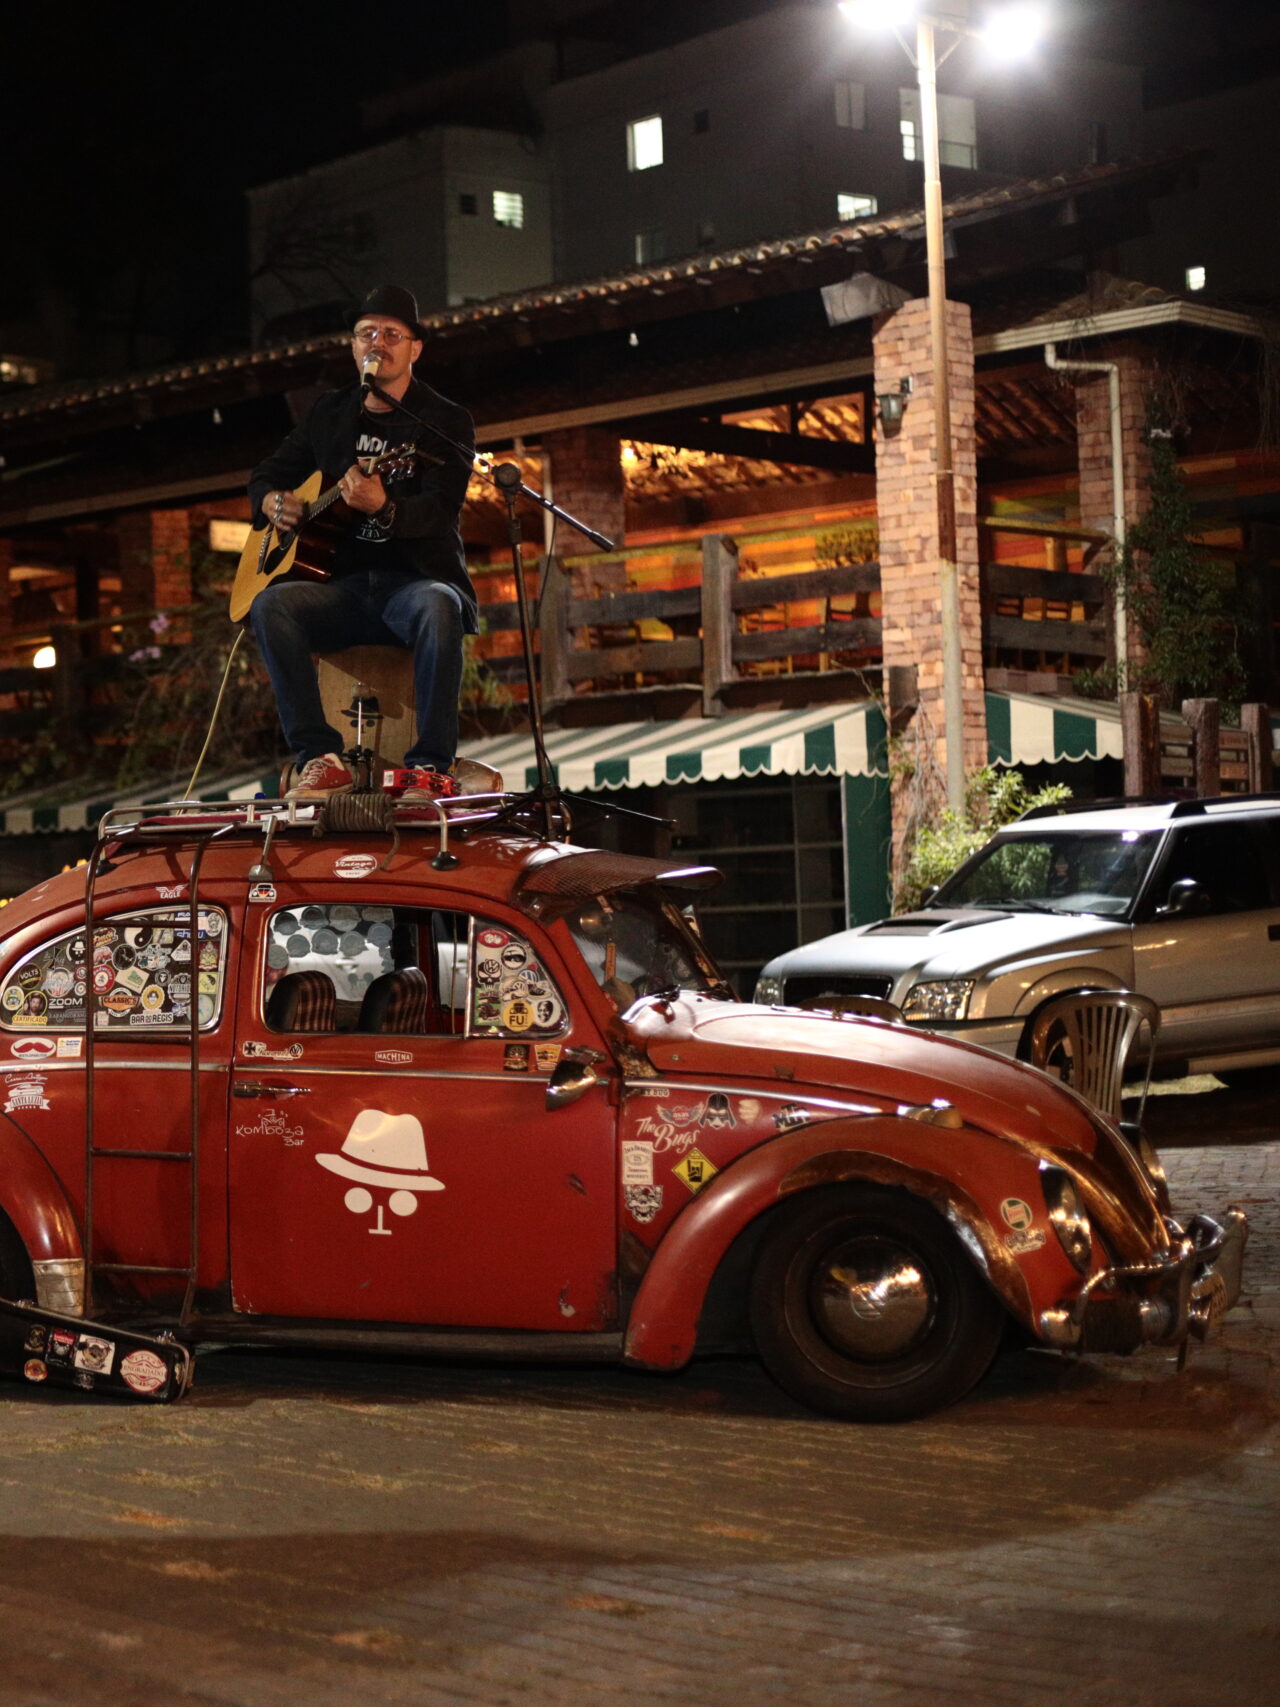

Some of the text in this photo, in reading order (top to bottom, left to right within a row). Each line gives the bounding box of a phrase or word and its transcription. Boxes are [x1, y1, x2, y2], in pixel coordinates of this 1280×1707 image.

[160, 890, 182, 899] EAGLE
[19, 968, 40, 980] VOLTS
[48, 997, 84, 1007] ZOOM
[131, 1015, 145, 1024] BAR
[377, 1052, 411, 1062] MACHINA
[635, 1116, 656, 1137] The
[651, 1123, 700, 1154] Bugs
